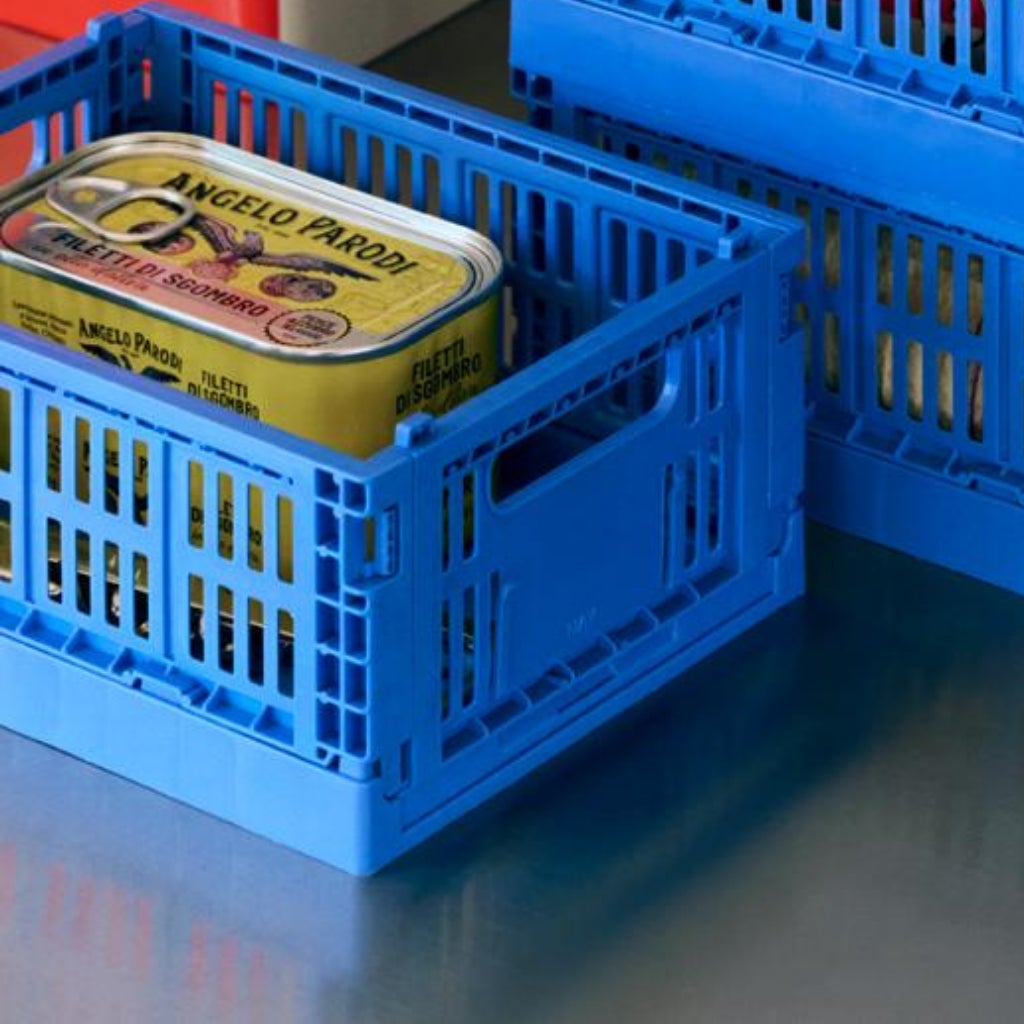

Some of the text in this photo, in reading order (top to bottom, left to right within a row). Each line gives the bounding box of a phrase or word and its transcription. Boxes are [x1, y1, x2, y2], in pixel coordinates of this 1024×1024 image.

[160, 172, 420, 276] ANGELO PARODI
[51, 232, 140, 268] FILETTI
[135, 262, 167, 278] DI
[161, 273, 271, 318] SGOMBRO
[79, 318, 131, 348] ANGELO
[134, 331, 183, 373] PARODI
[411, 337, 465, 382] FILETTI
[187, 382, 202, 397] DI
[201, 369, 249, 399] FILETTI
[395, 389, 411, 415] DI
[412, 353, 482, 404] SGOMBRO
